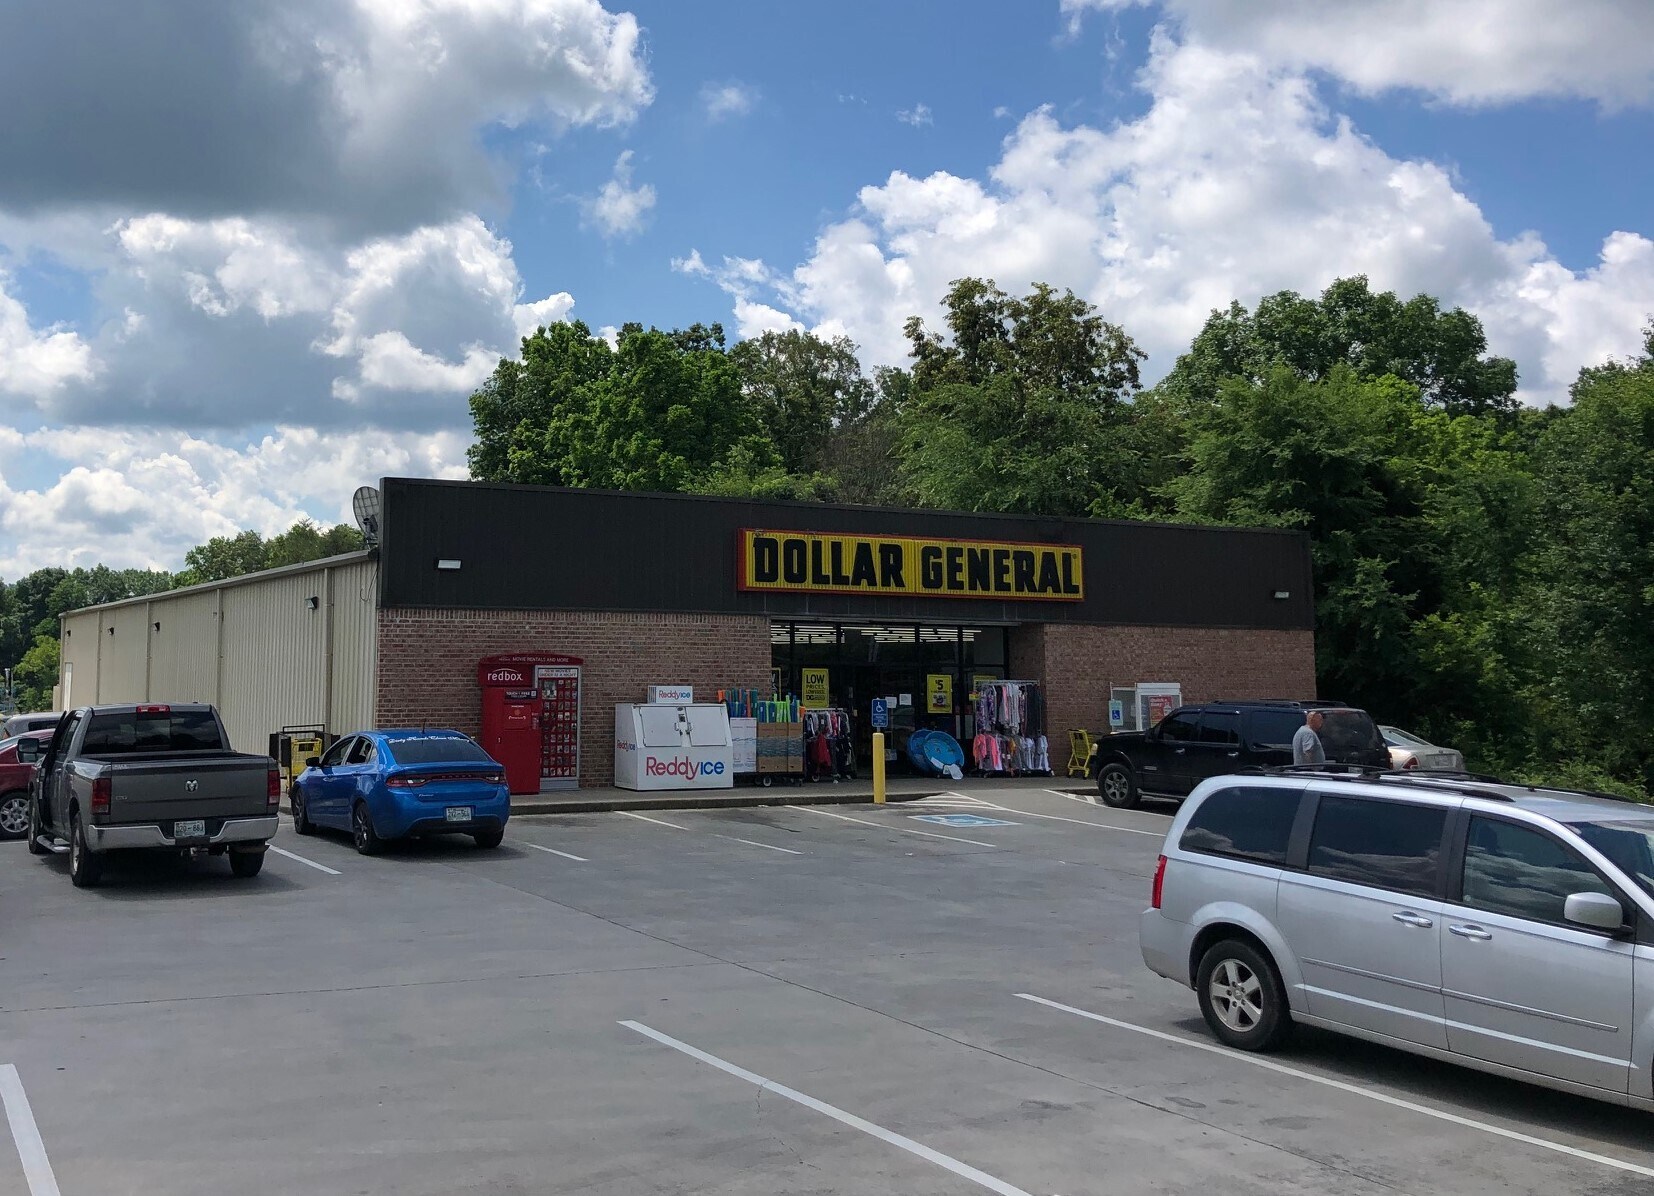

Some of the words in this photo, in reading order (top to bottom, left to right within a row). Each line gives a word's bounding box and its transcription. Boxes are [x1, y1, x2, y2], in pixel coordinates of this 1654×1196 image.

[753, 537, 905, 588] DOLLAR
[921, 545, 1079, 594] GENERAL
[487, 670, 523, 681] redbox
[806, 674, 825, 684] LOW
